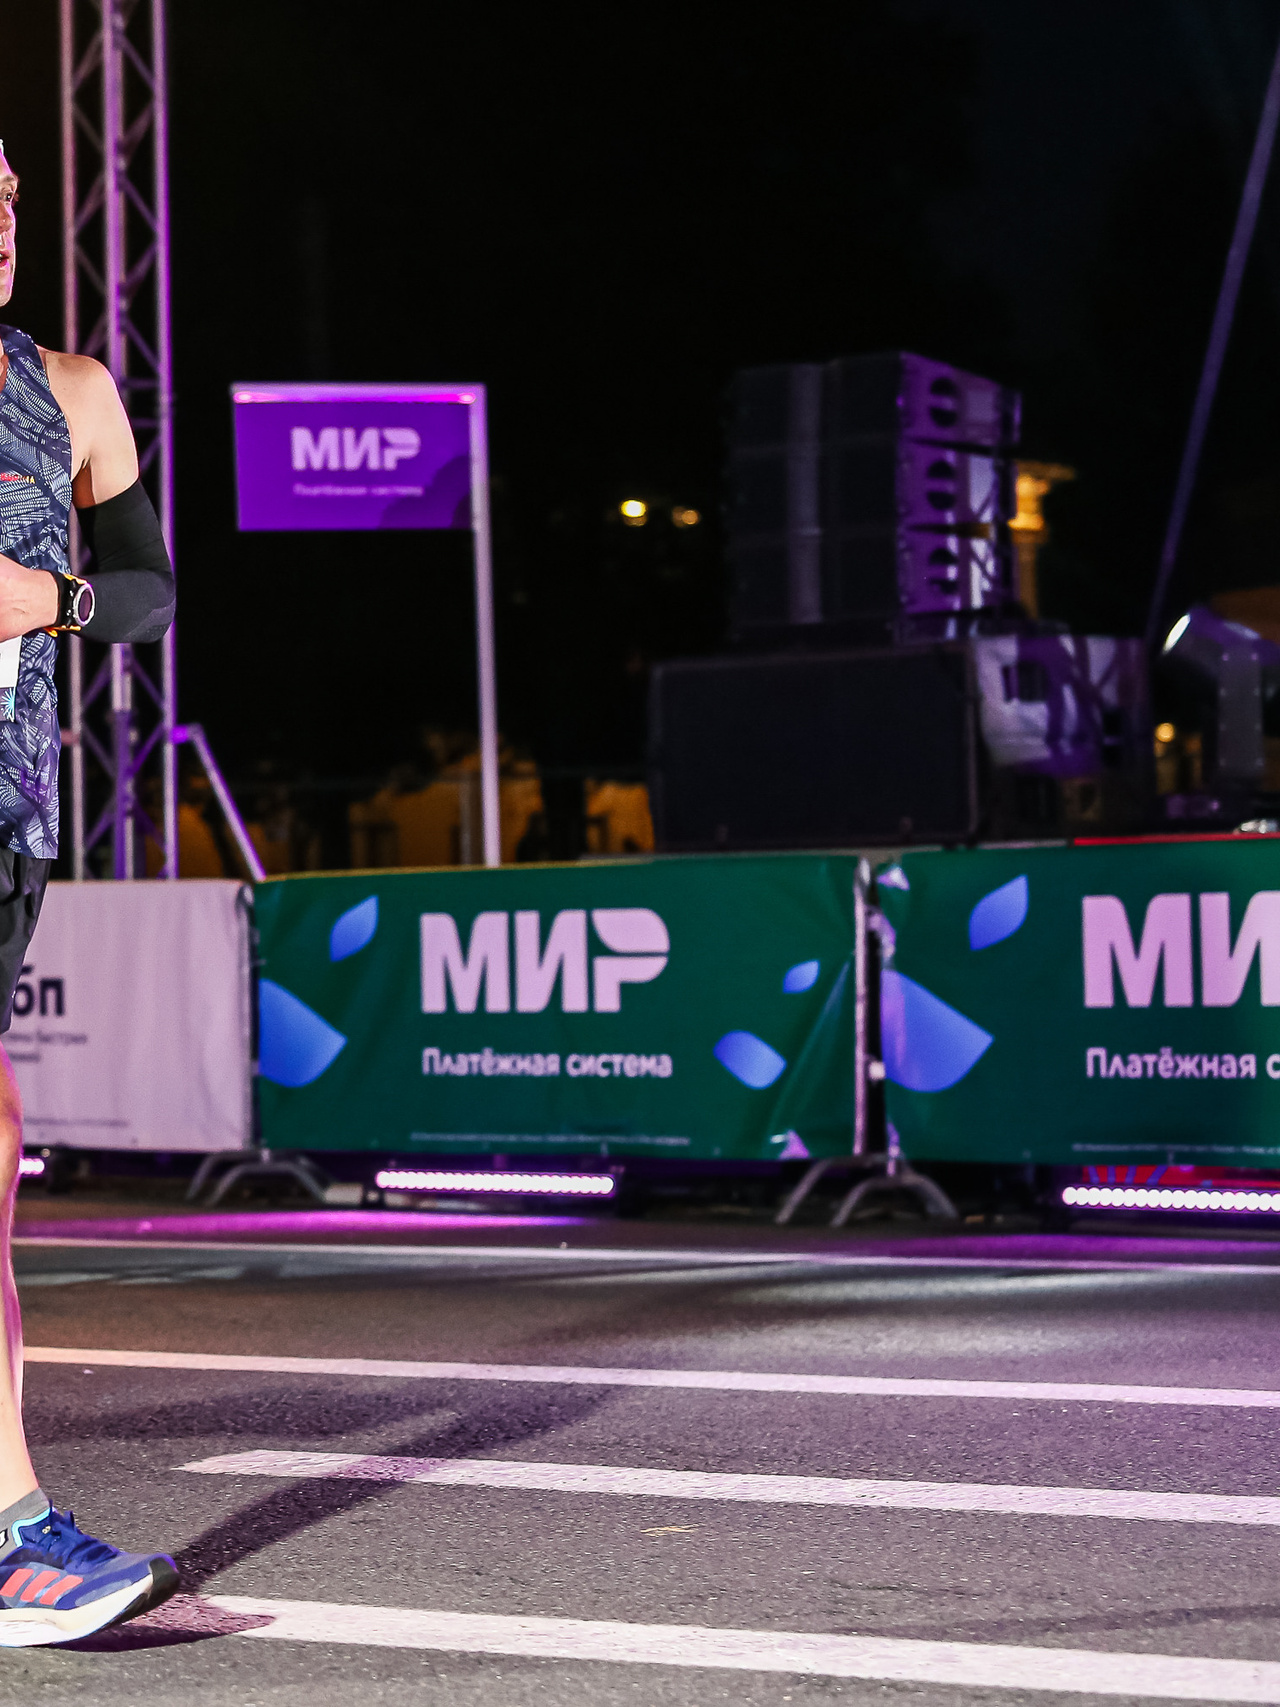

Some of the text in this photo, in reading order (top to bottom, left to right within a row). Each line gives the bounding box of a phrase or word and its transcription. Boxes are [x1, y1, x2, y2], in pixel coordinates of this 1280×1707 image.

[291, 426, 421, 470] МИР
[420, 907, 669, 1014] МИР
[1082, 890, 1280, 1008] МИ
[13, 964, 66, 1016] бп
[422, 1046, 674, 1078] Платёжная система
[1086, 1046, 1257, 1079] Платёжная
